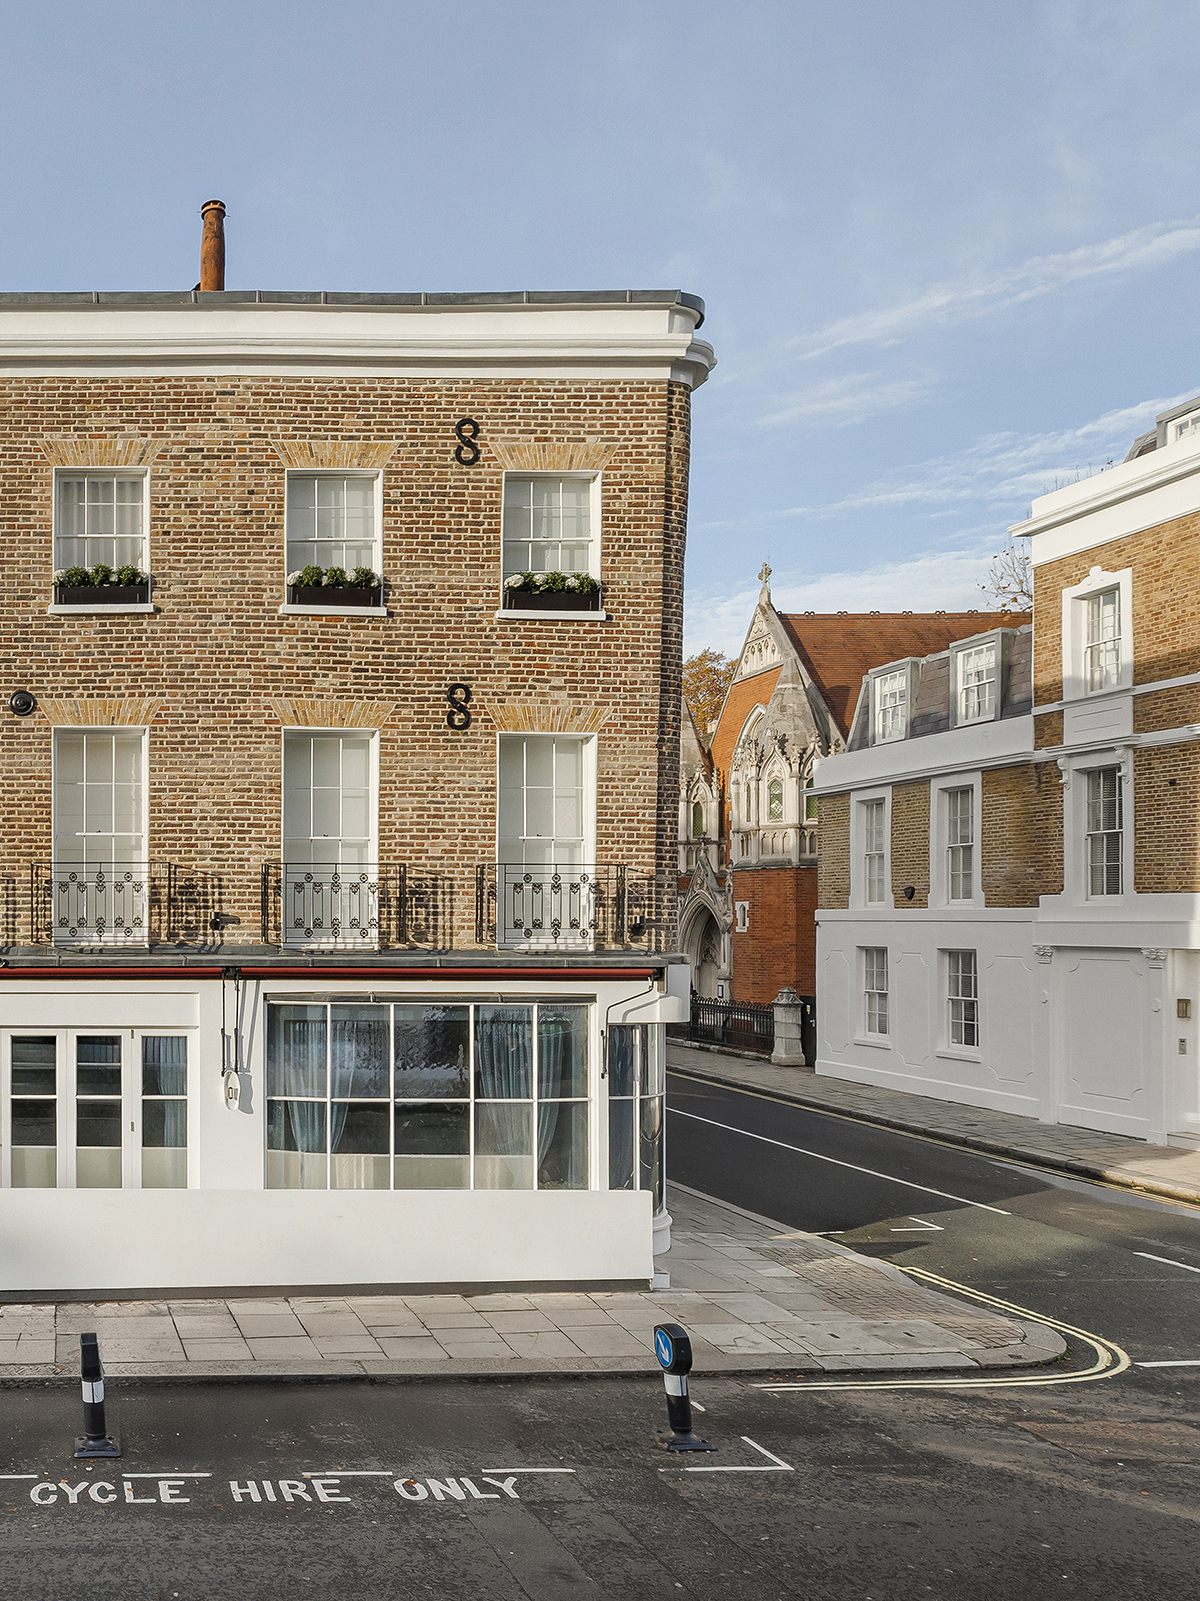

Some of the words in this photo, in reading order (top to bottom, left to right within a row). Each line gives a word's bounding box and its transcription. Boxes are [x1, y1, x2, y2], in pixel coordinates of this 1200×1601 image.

[29, 1480, 191, 1504] CYCLE
[228, 1479, 353, 1503] HIRE
[392, 1476, 521, 1501] ONLY
